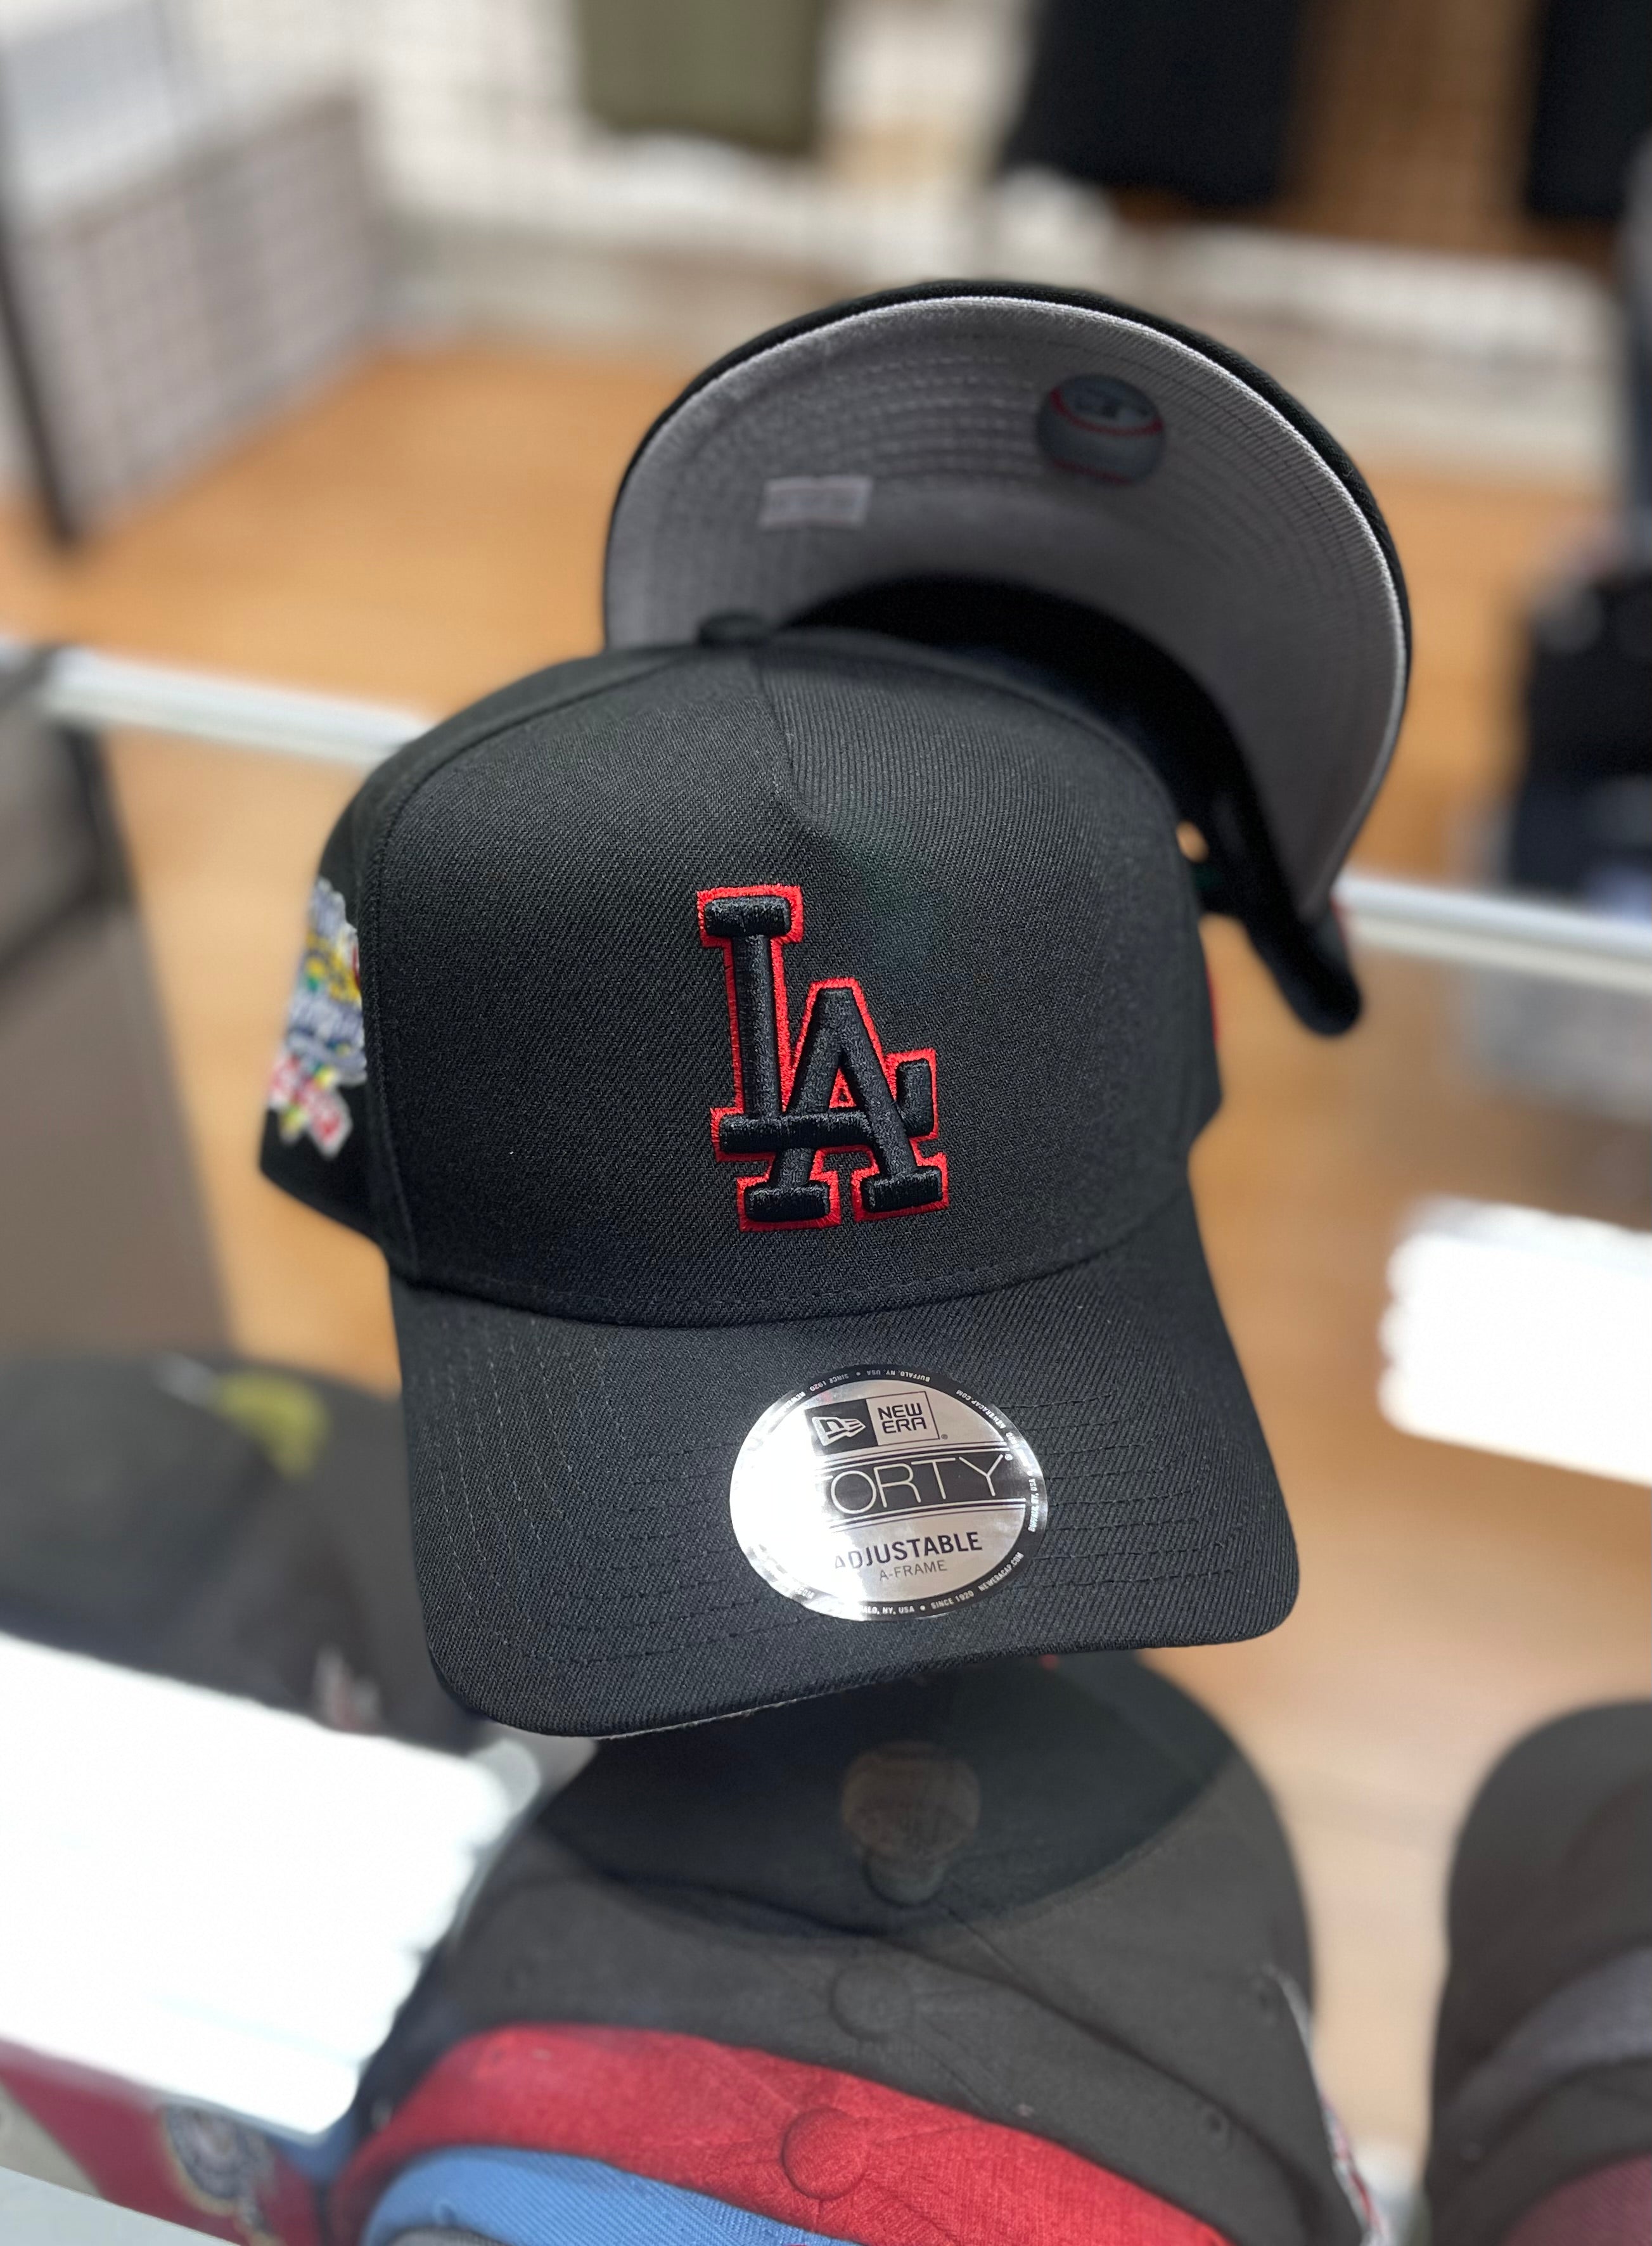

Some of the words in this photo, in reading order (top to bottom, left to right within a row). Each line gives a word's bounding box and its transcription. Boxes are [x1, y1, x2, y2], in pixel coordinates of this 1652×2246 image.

[697, 884, 949, 1231] LA
[809, 1380, 827, 1392] 1920
[828, 1373, 849, 1383] SINCE
[877, 1402, 923, 1420] NEW
[881, 1416, 928, 1434] ERA
[819, 1454, 1004, 1515] ORTY
[1028, 1479, 1038, 1492] USA
[834, 1531, 982, 1570] ADJUSTABLE
[880, 1559, 947, 1581] A-FRAME
[930, 1597, 954, 1610] SINCE
[955, 1589, 975, 1603] 1920
[978, 1551, 1024, 1592] NEWERACAP.COM
[898, 1605, 915, 1614] USA
